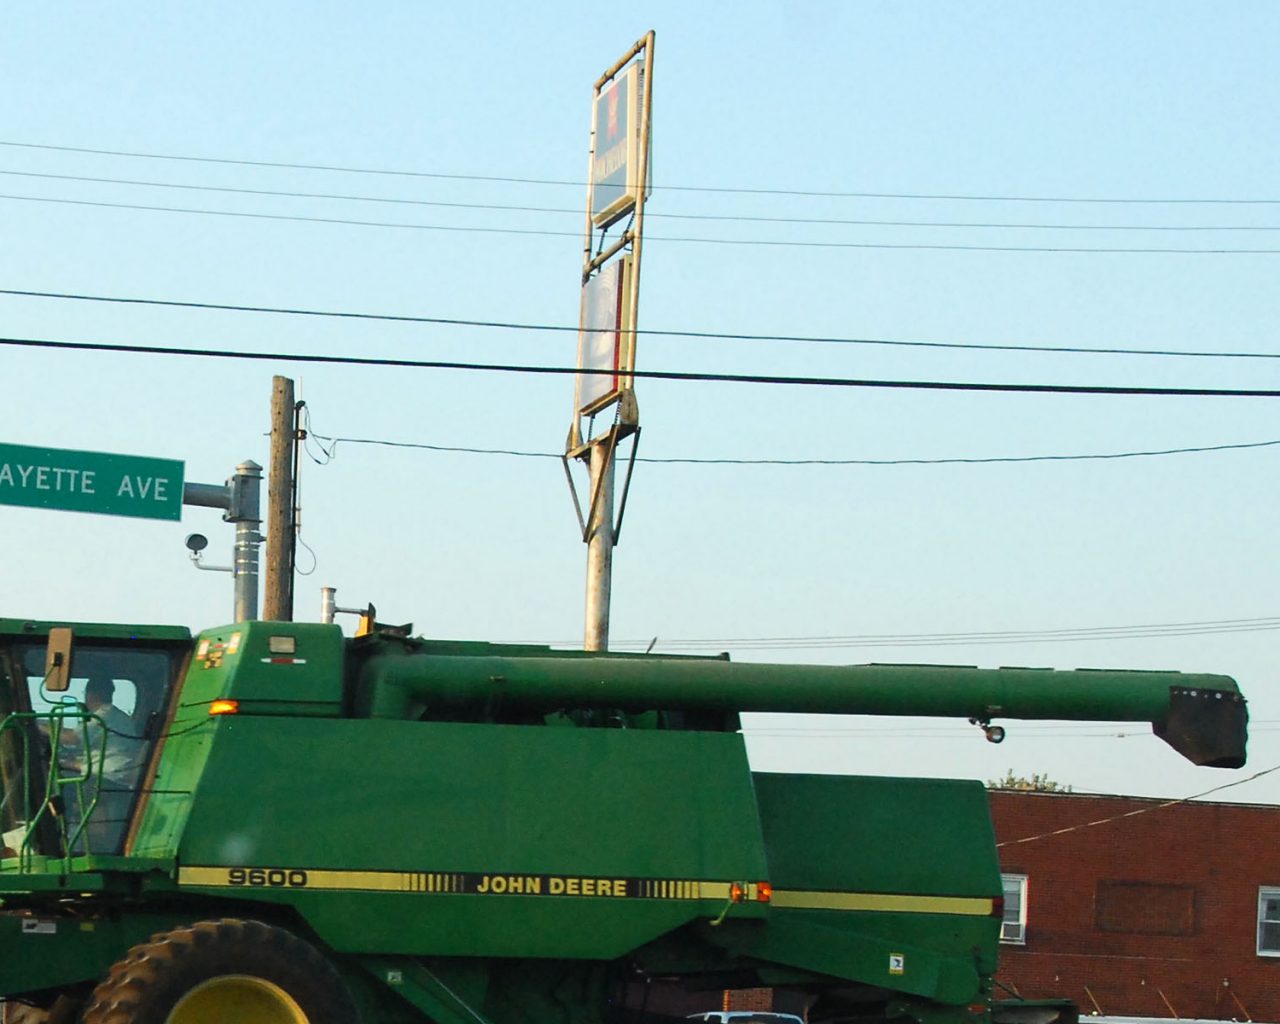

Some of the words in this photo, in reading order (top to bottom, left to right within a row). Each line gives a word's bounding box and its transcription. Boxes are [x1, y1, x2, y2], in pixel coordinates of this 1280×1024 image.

[117, 475, 169, 501] AVE
[228, 868, 308, 887] 9600
[477, 876, 541, 895] JOHN
[549, 877, 627, 897] DEERE
